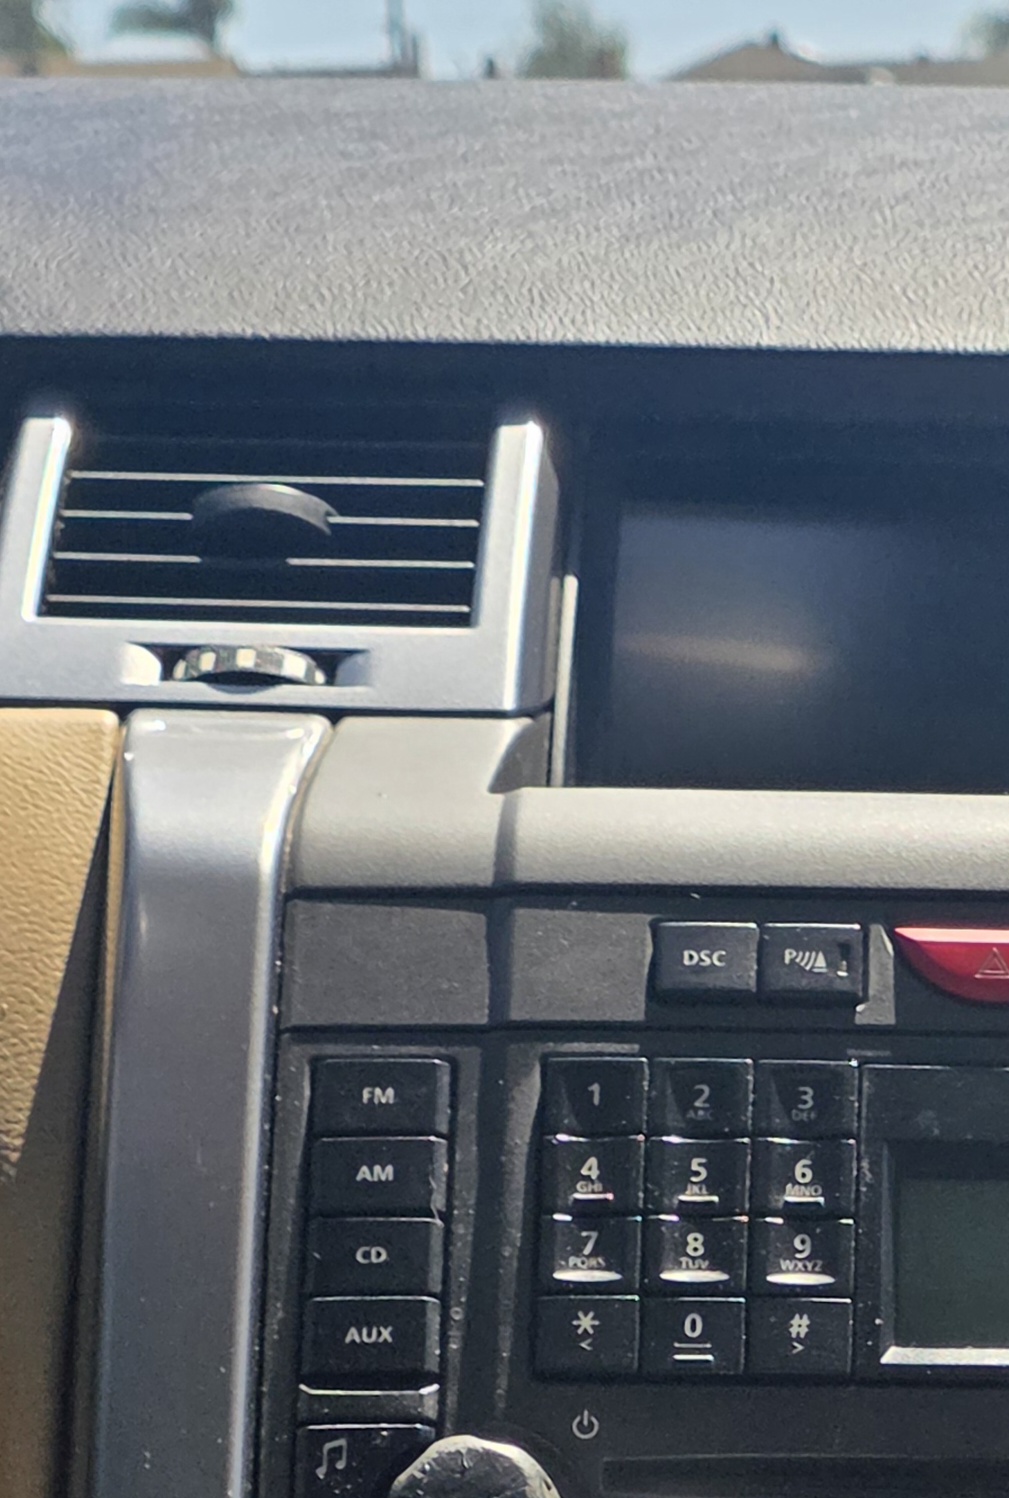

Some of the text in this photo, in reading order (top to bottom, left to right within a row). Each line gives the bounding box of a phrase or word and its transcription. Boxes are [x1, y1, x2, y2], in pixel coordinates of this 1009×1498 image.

[683, 950, 727, 967] DSC
[361, 1087, 394, 1104] FM
[587, 1083, 601, 1106] 1
[693, 1084, 710, 1107] 2
[797, 1087, 814, 1109] 3
[355, 1165, 395, 1182] AM
[580, 1156, 600, 1180] 4
[691, 1158, 707, 1182] 5
[794, 1159, 813, 1184] 6
[784, 1183, 823, 1196] MNO
[581, 1231, 599, 1255] 7
[686, 1233, 705, 1257] 8
[793, 1234, 812, 1259] 9
[355, 1247, 387, 1264] CD
[678, 1257, 710, 1270] TUV
[779, 1259, 824, 1272] WXYZ
[345, 1327, 393, 1344] AUX
[684, 1313, 703, 1337] 0
